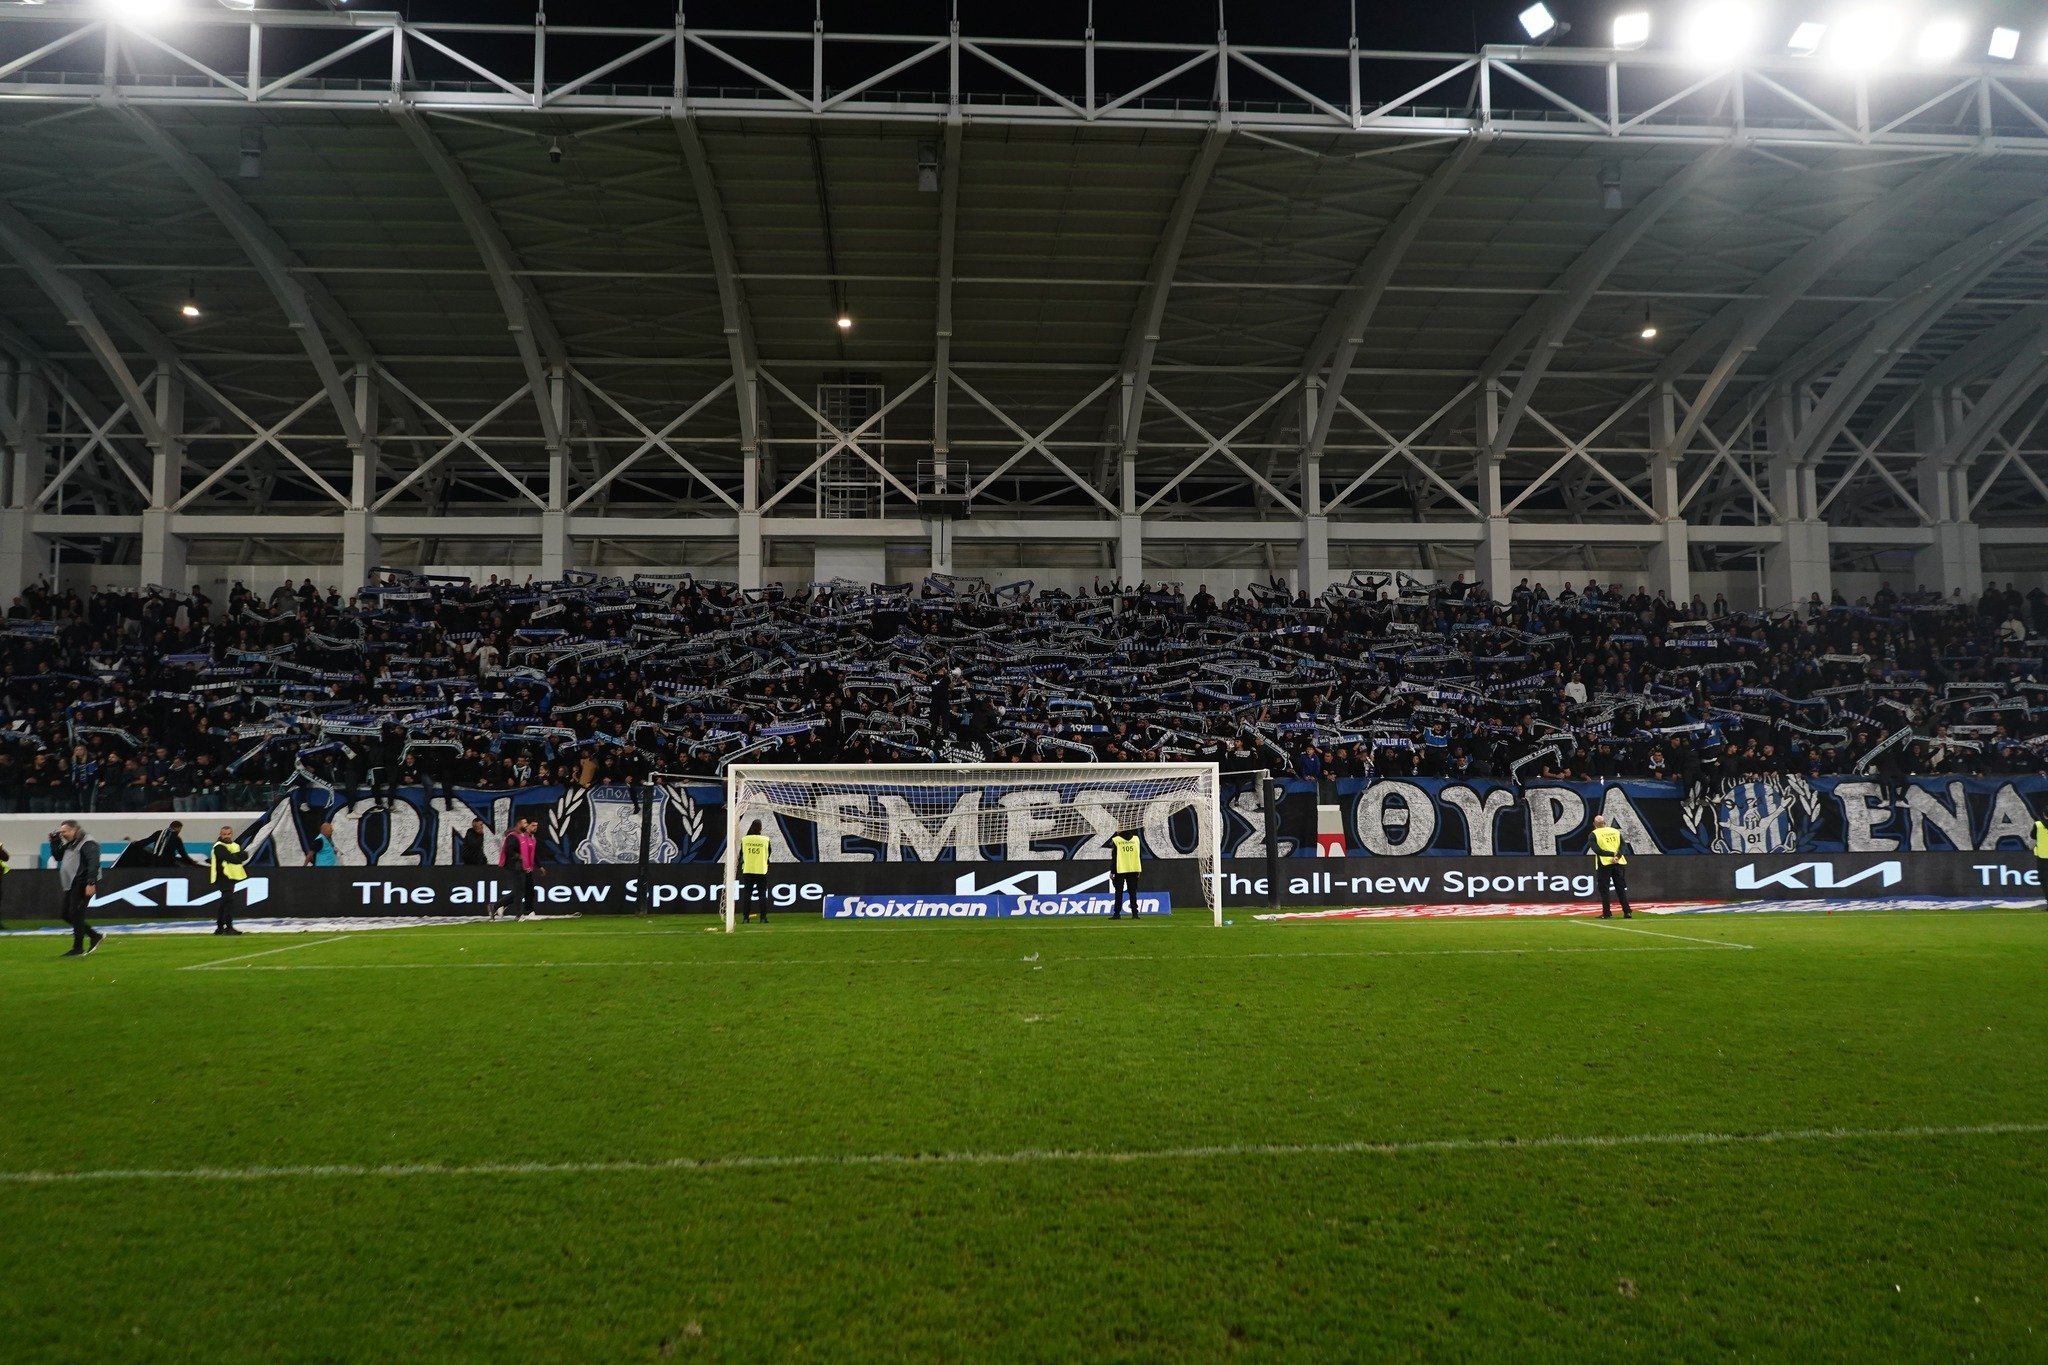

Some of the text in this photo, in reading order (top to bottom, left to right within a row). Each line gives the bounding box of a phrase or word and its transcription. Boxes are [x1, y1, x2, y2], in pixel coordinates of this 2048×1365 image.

[747, 847, 761, 855] 165
[1288, 872, 1431, 894] all-new
[1972, 865, 2041, 886] The
[352, 881, 436, 905] The
[835, 896, 988, 918] Stoiximan
